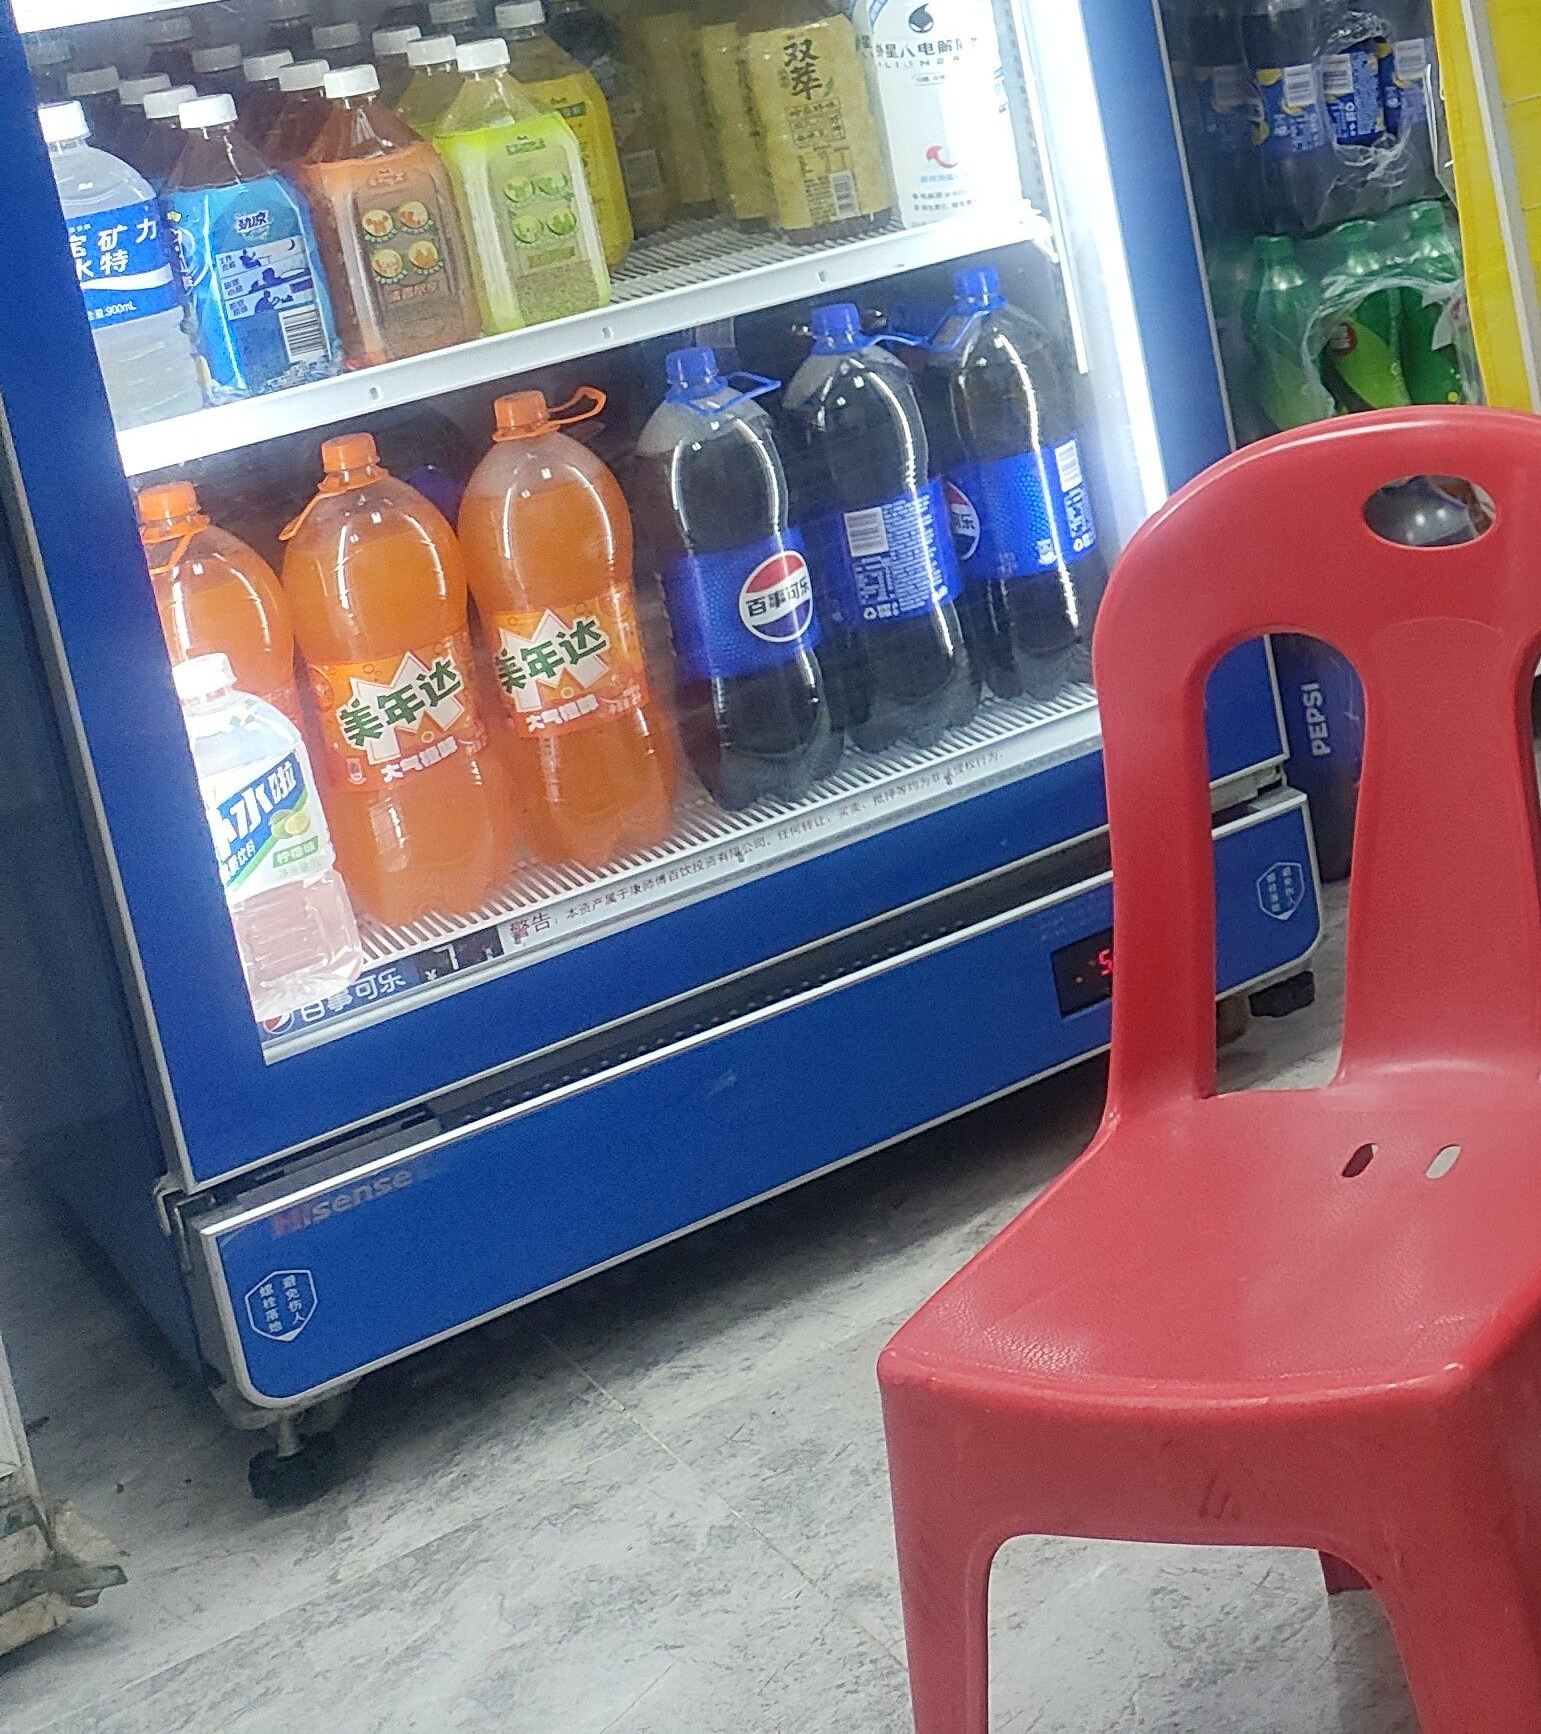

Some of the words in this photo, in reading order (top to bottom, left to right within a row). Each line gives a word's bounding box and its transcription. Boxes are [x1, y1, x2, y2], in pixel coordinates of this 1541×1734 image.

[745, 577, 811, 617] 百事可乐
[495, 617, 611, 694] 美年达
[341, 657, 464, 747] 美年达
[1301, 682, 1332, 758] PEPSI
[299, 969, 405, 1021] 百事可乐
[270, 1169, 414, 1240] Hisense
